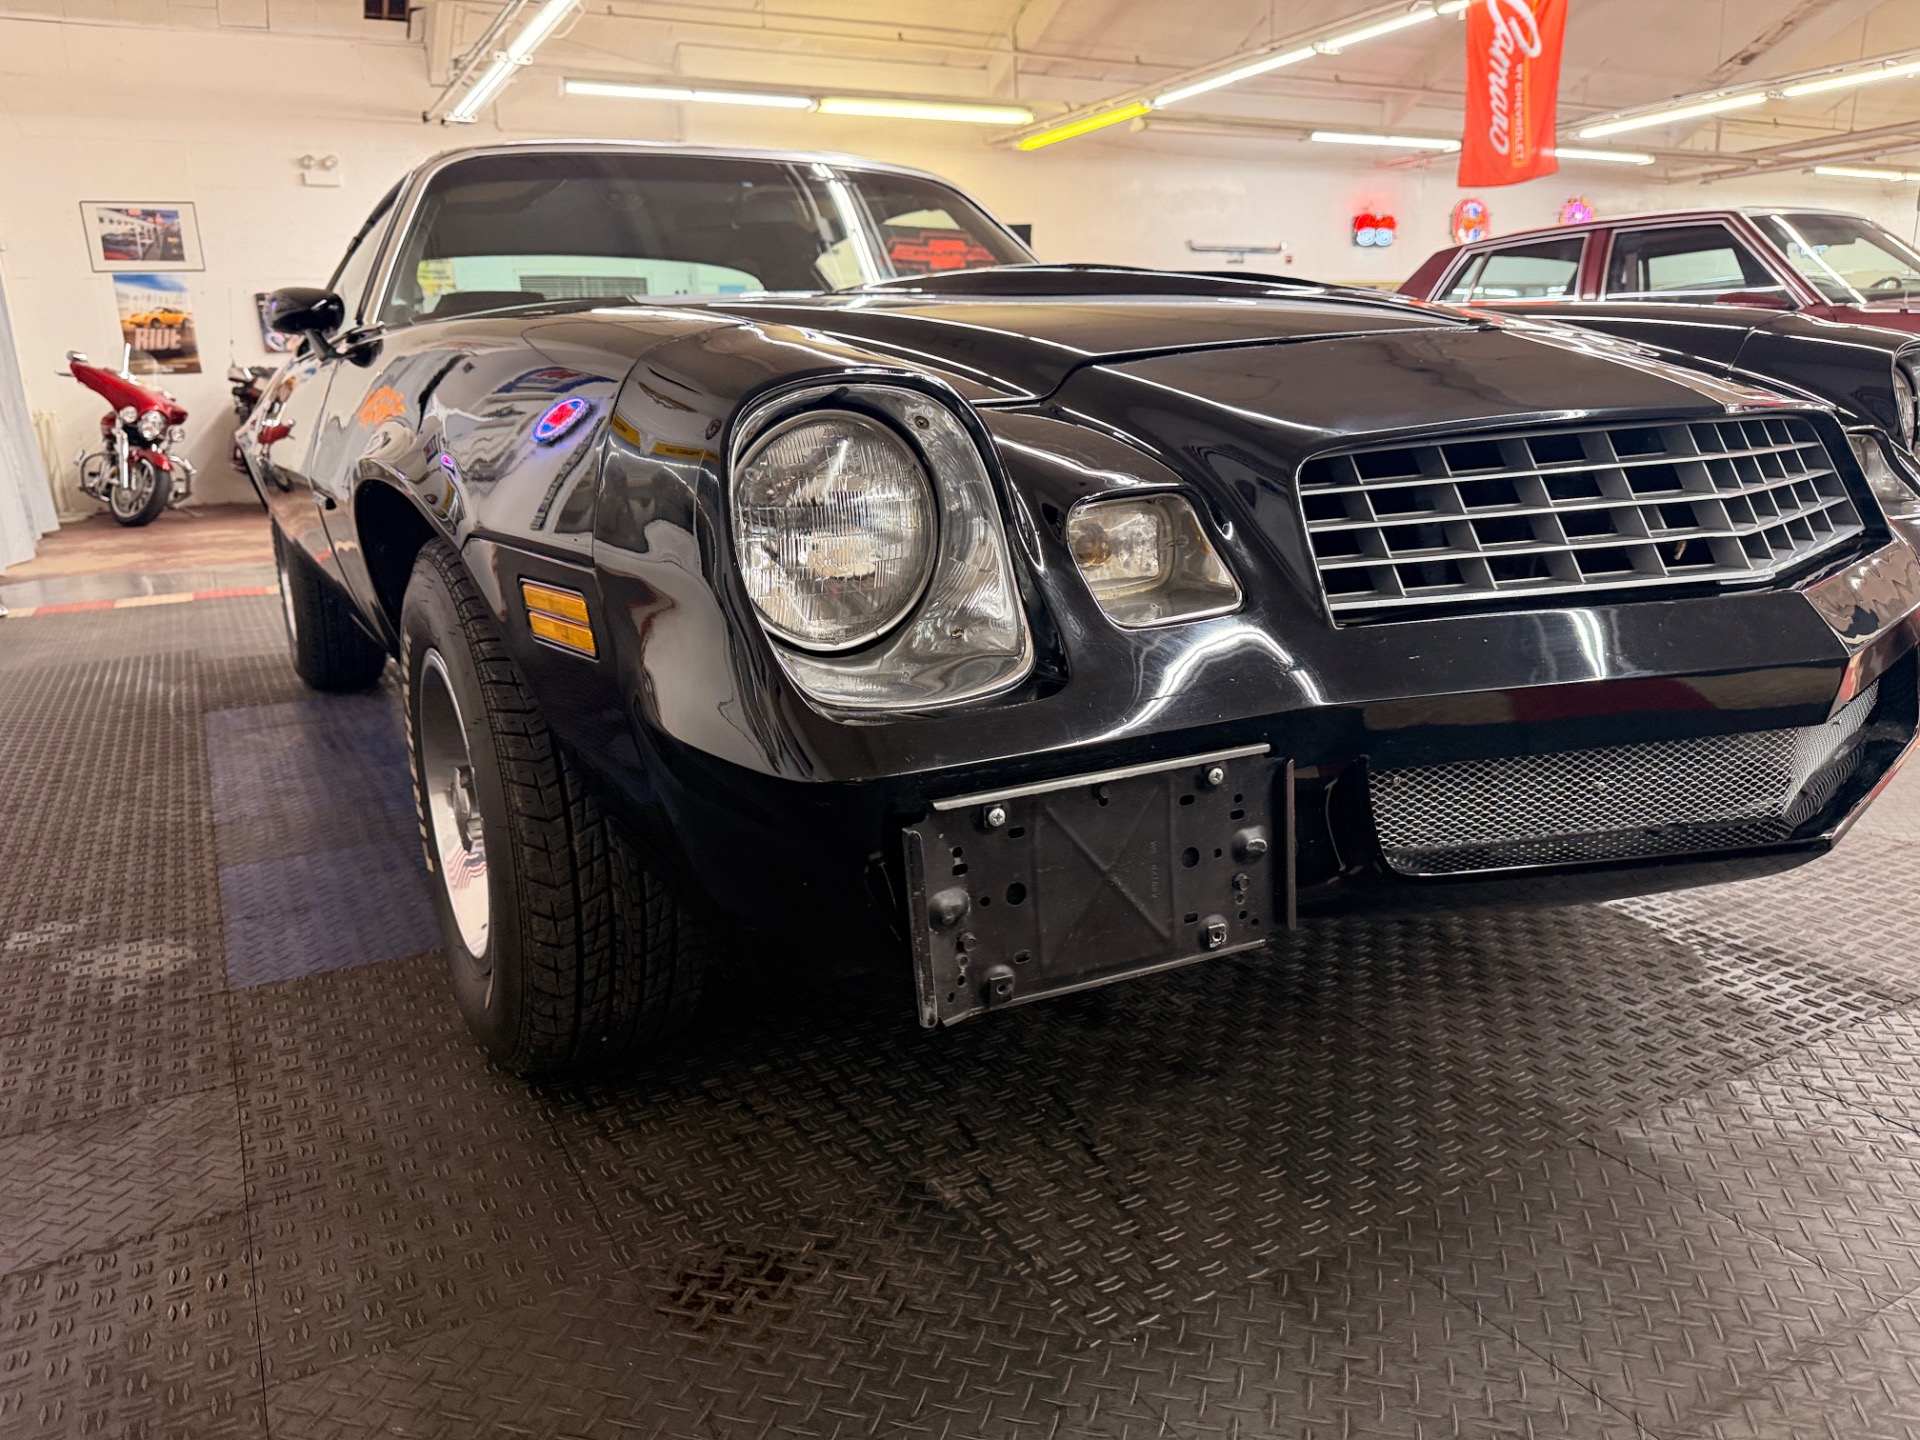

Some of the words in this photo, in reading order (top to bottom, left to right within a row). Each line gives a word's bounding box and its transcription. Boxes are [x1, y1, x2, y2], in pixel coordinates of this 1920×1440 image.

[1487, 0, 1542, 155] Camaro
[1514, 63, 1523, 80] BY
[1514, 81, 1525, 160] CHEVROLET
[1356, 227, 1393, 247] SS
[135, 328, 181, 351] RIDE
